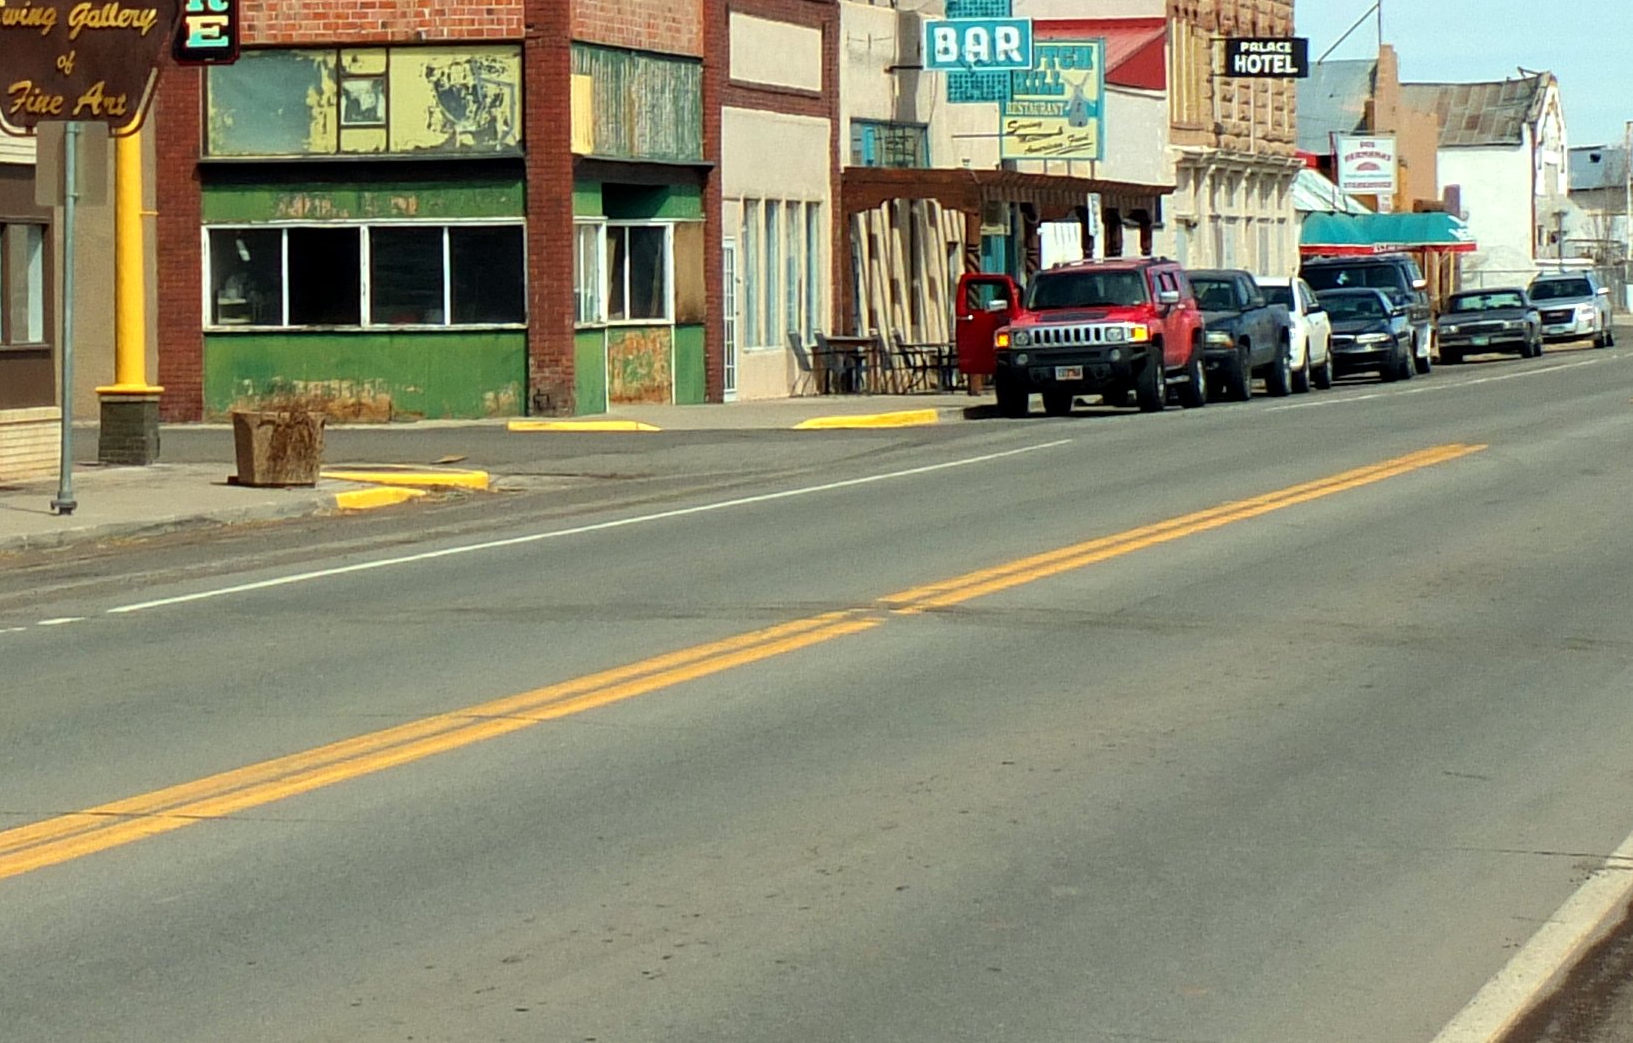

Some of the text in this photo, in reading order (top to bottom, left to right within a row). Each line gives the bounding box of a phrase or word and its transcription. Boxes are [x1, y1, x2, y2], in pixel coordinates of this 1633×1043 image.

[68, 1, 158, 40] Gallery
[932, 25, 1024, 63] BAR
[1240, 41, 1292, 53] PALACE
[57, 49, 74, 74] of
[1234, 54, 1298, 73] HOTEL
[7, 80, 127, 117] Fine Art
